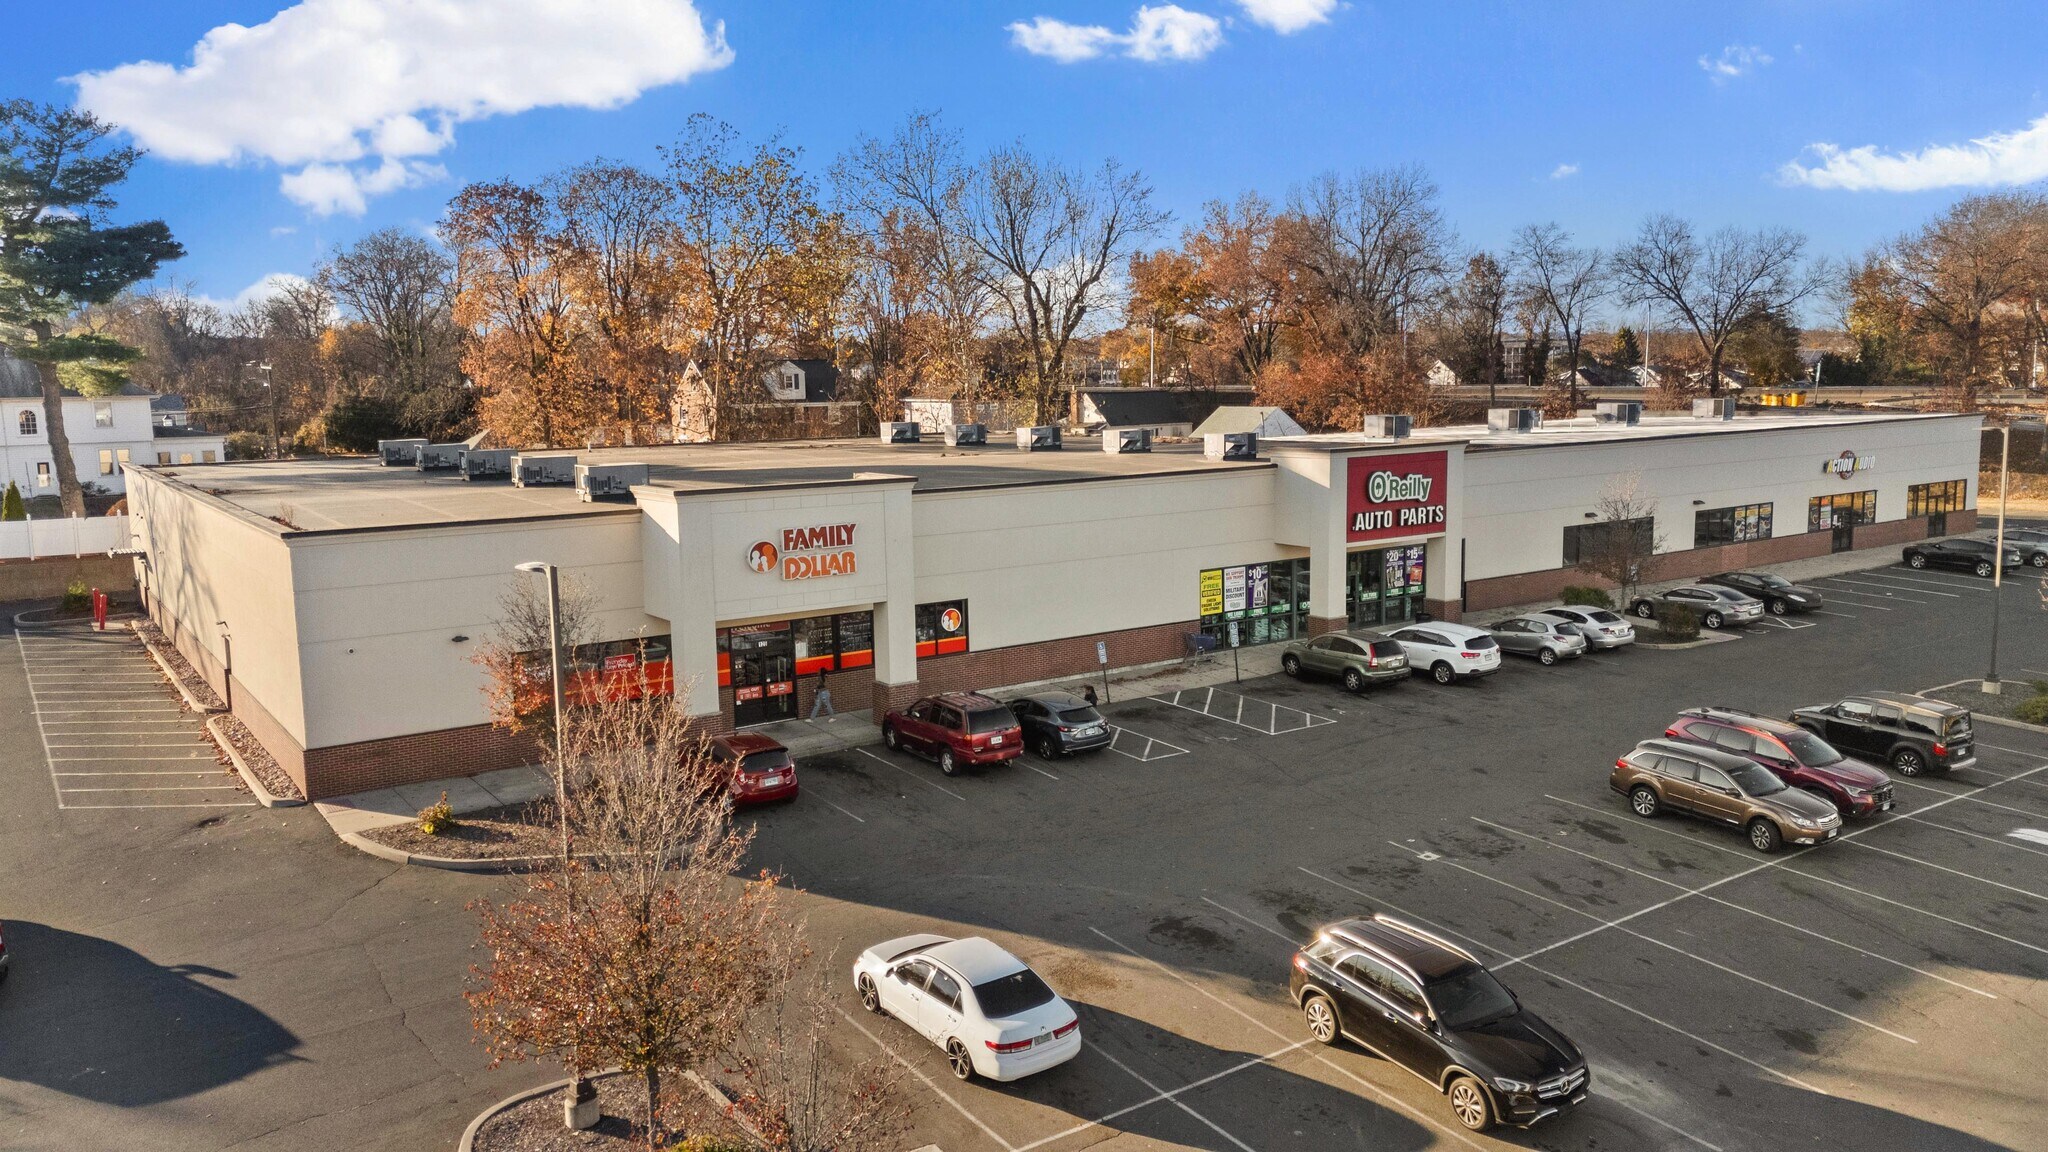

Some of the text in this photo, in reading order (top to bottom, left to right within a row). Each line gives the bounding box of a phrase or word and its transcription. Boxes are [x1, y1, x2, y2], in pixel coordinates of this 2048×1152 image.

[1827, 456, 1875, 473] ACTION AUDIO
[1369, 472, 1431, 502] O'Reilly
[1355, 505, 1444, 531] AUTO PARTS
[783, 523, 857, 552] FAMILY
[1386, 552, 1399, 562] $20
[1407, 549, 1418, 559] $15
[783, 551, 856, 581] DOLLAR
[1249, 569, 1262, 579] $10
